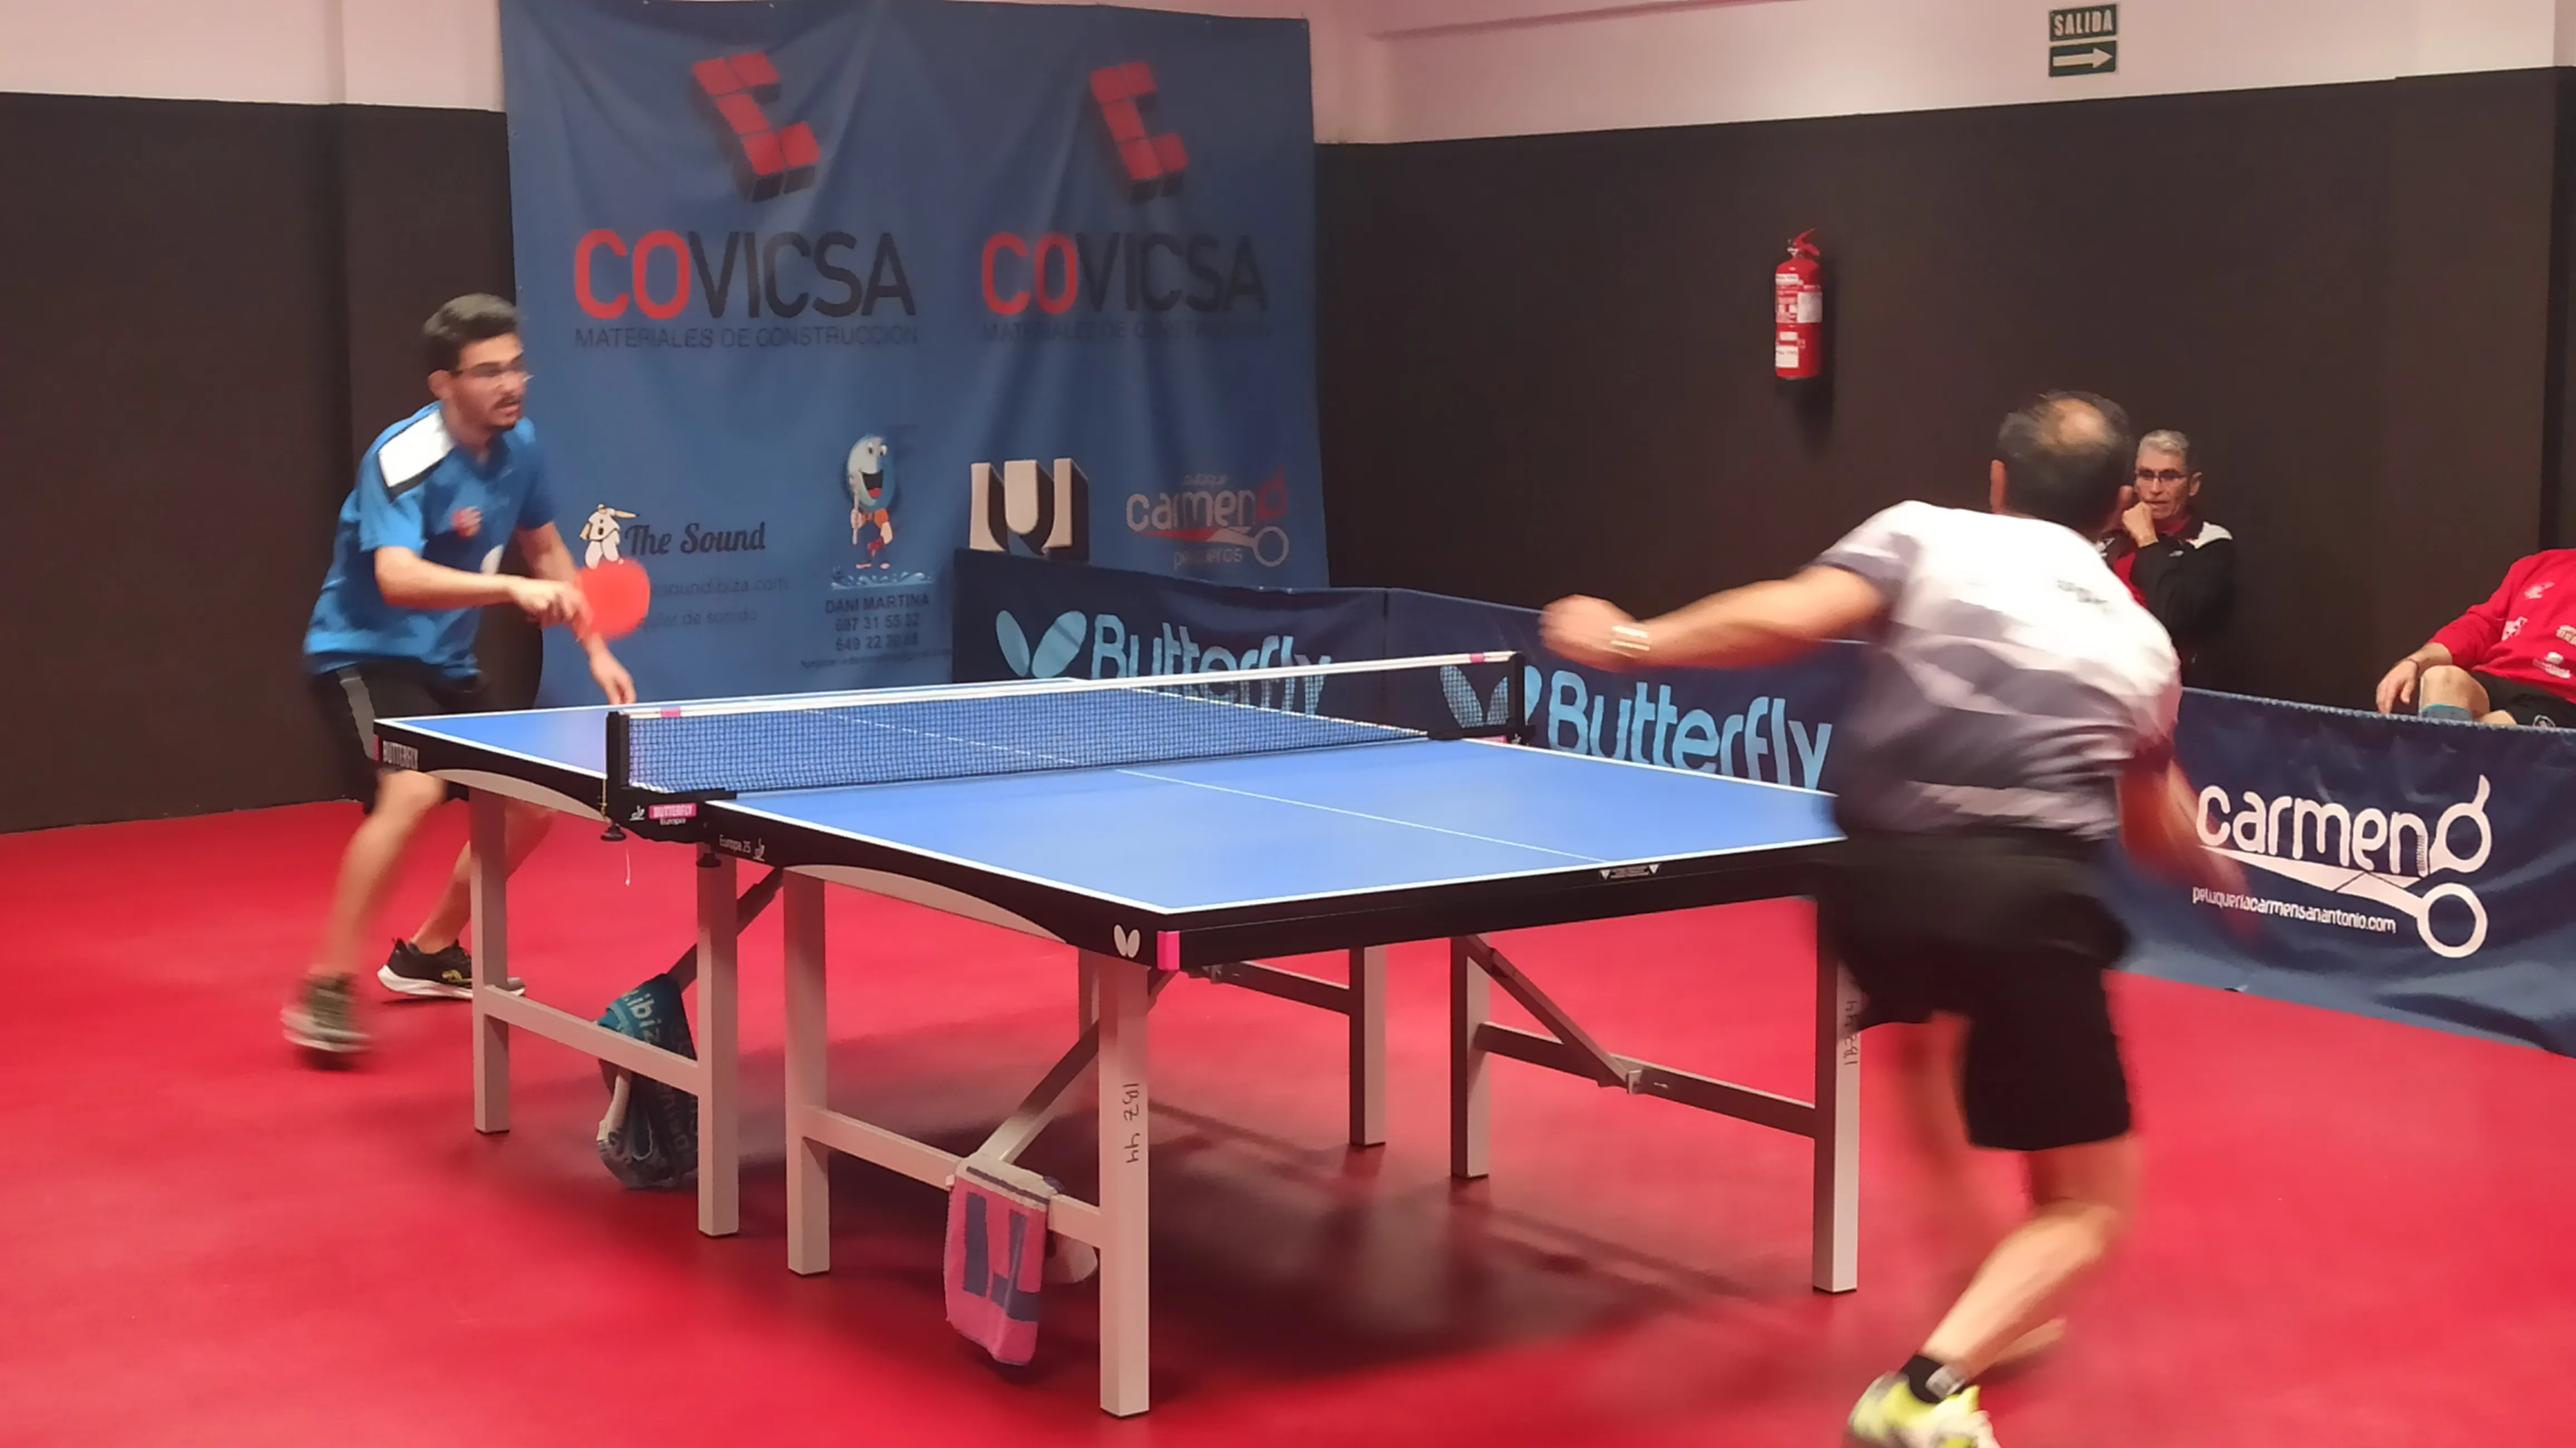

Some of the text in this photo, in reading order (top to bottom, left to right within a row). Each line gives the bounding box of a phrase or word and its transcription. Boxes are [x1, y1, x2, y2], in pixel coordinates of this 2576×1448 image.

[2053, 9, 2112, 36] SALIDA
[574, 229, 916, 320] COVICSA
[981, 232, 1268, 316] COVICSA
[574, 328, 713, 349] MATERIALES
[721, 327, 750, 348] DE
[625, 522, 766, 555] The Sound
[1091, 613, 1331, 715] Butterfly
[1547, 670, 1833, 791] Butterfly
[2196, 785, 2428, 878] carmen
